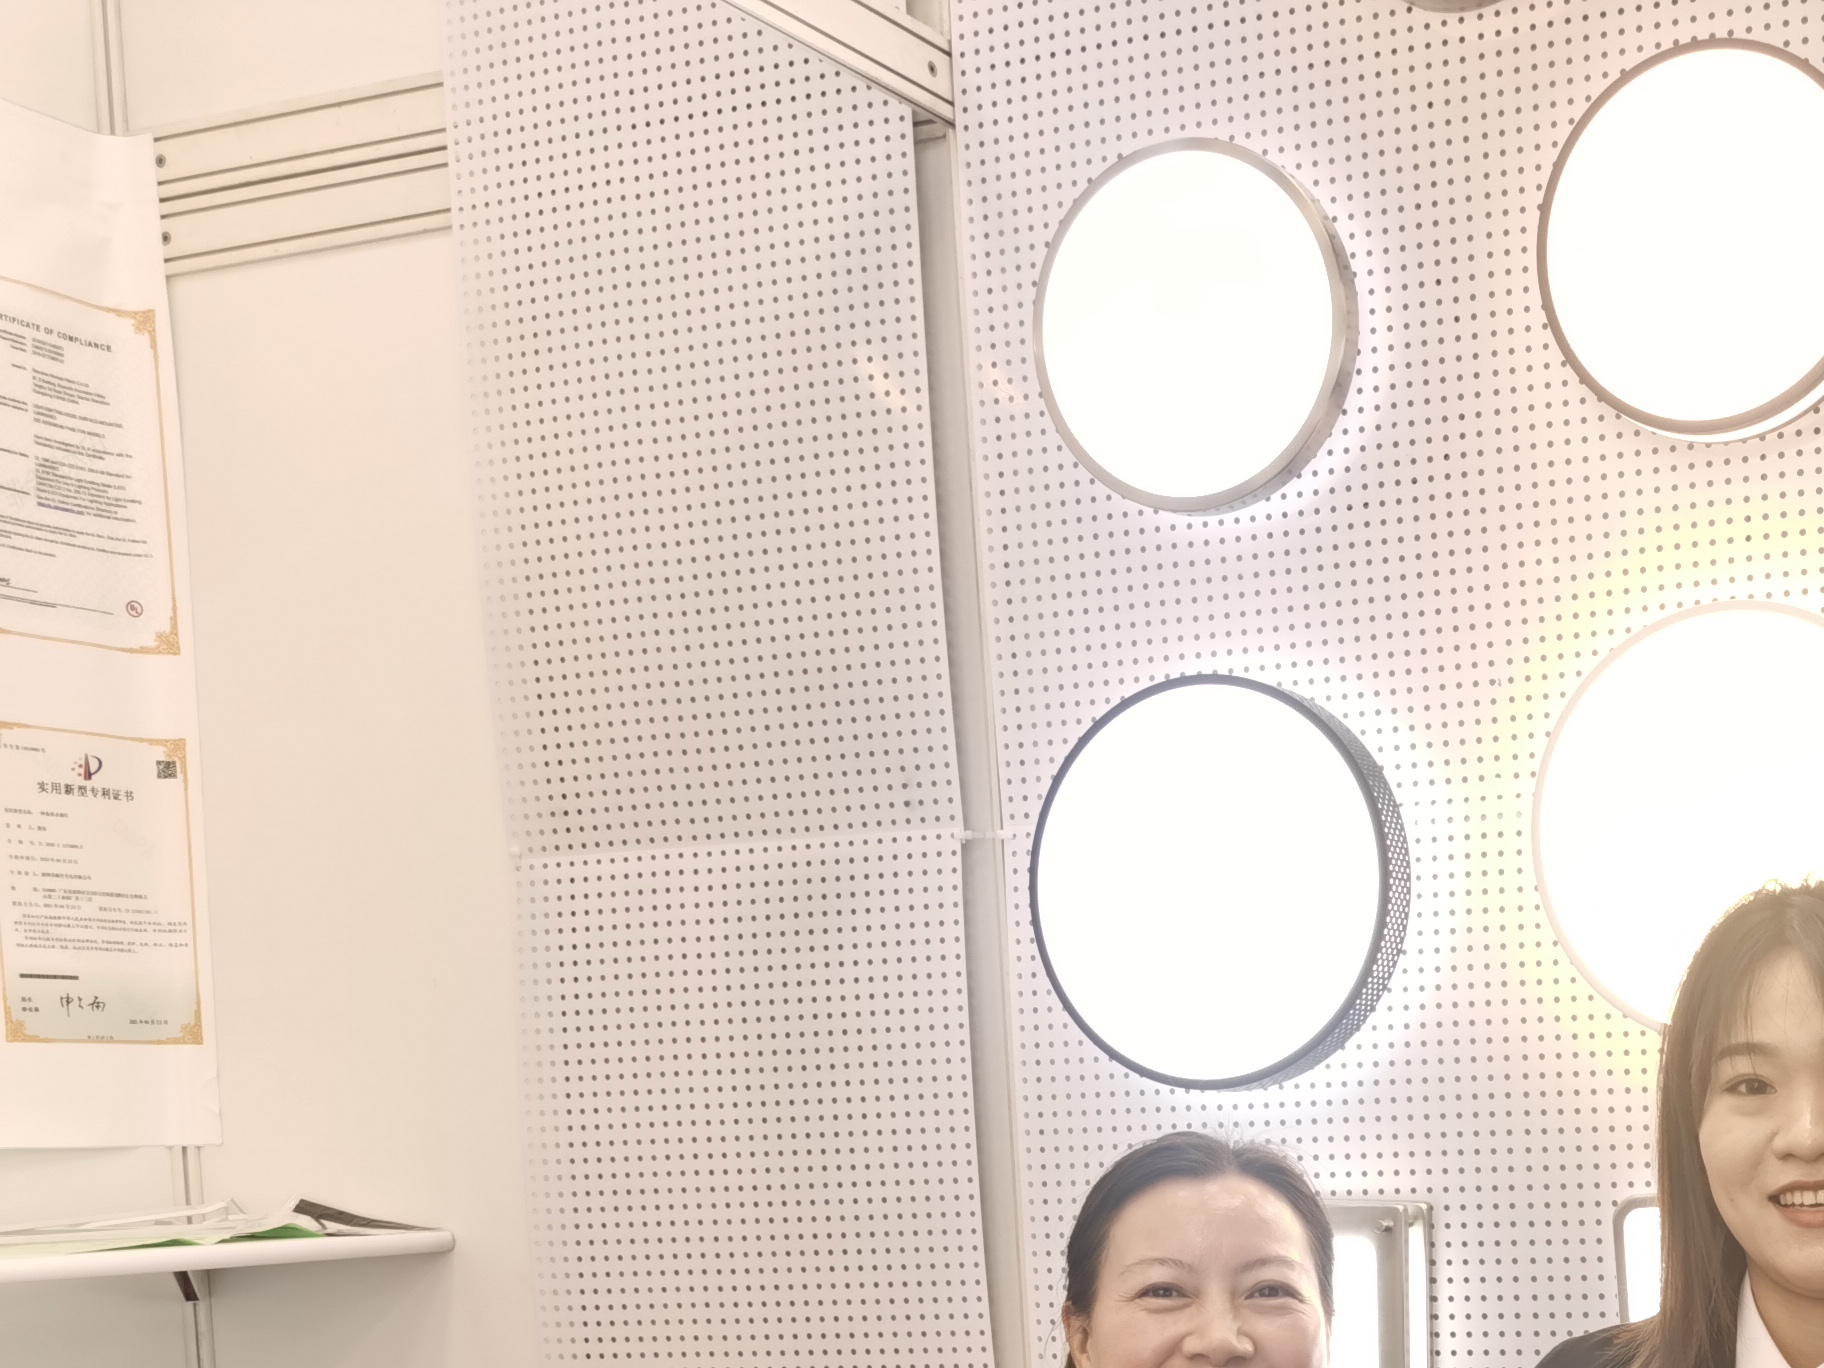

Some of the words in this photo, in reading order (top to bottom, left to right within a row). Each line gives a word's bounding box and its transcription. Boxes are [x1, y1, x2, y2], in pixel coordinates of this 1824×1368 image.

[44, 327, 54, 335] OF
[57, 331, 112, 352] COMPLIANCE
[37, 781, 134, 802] 实用新型专利证书
